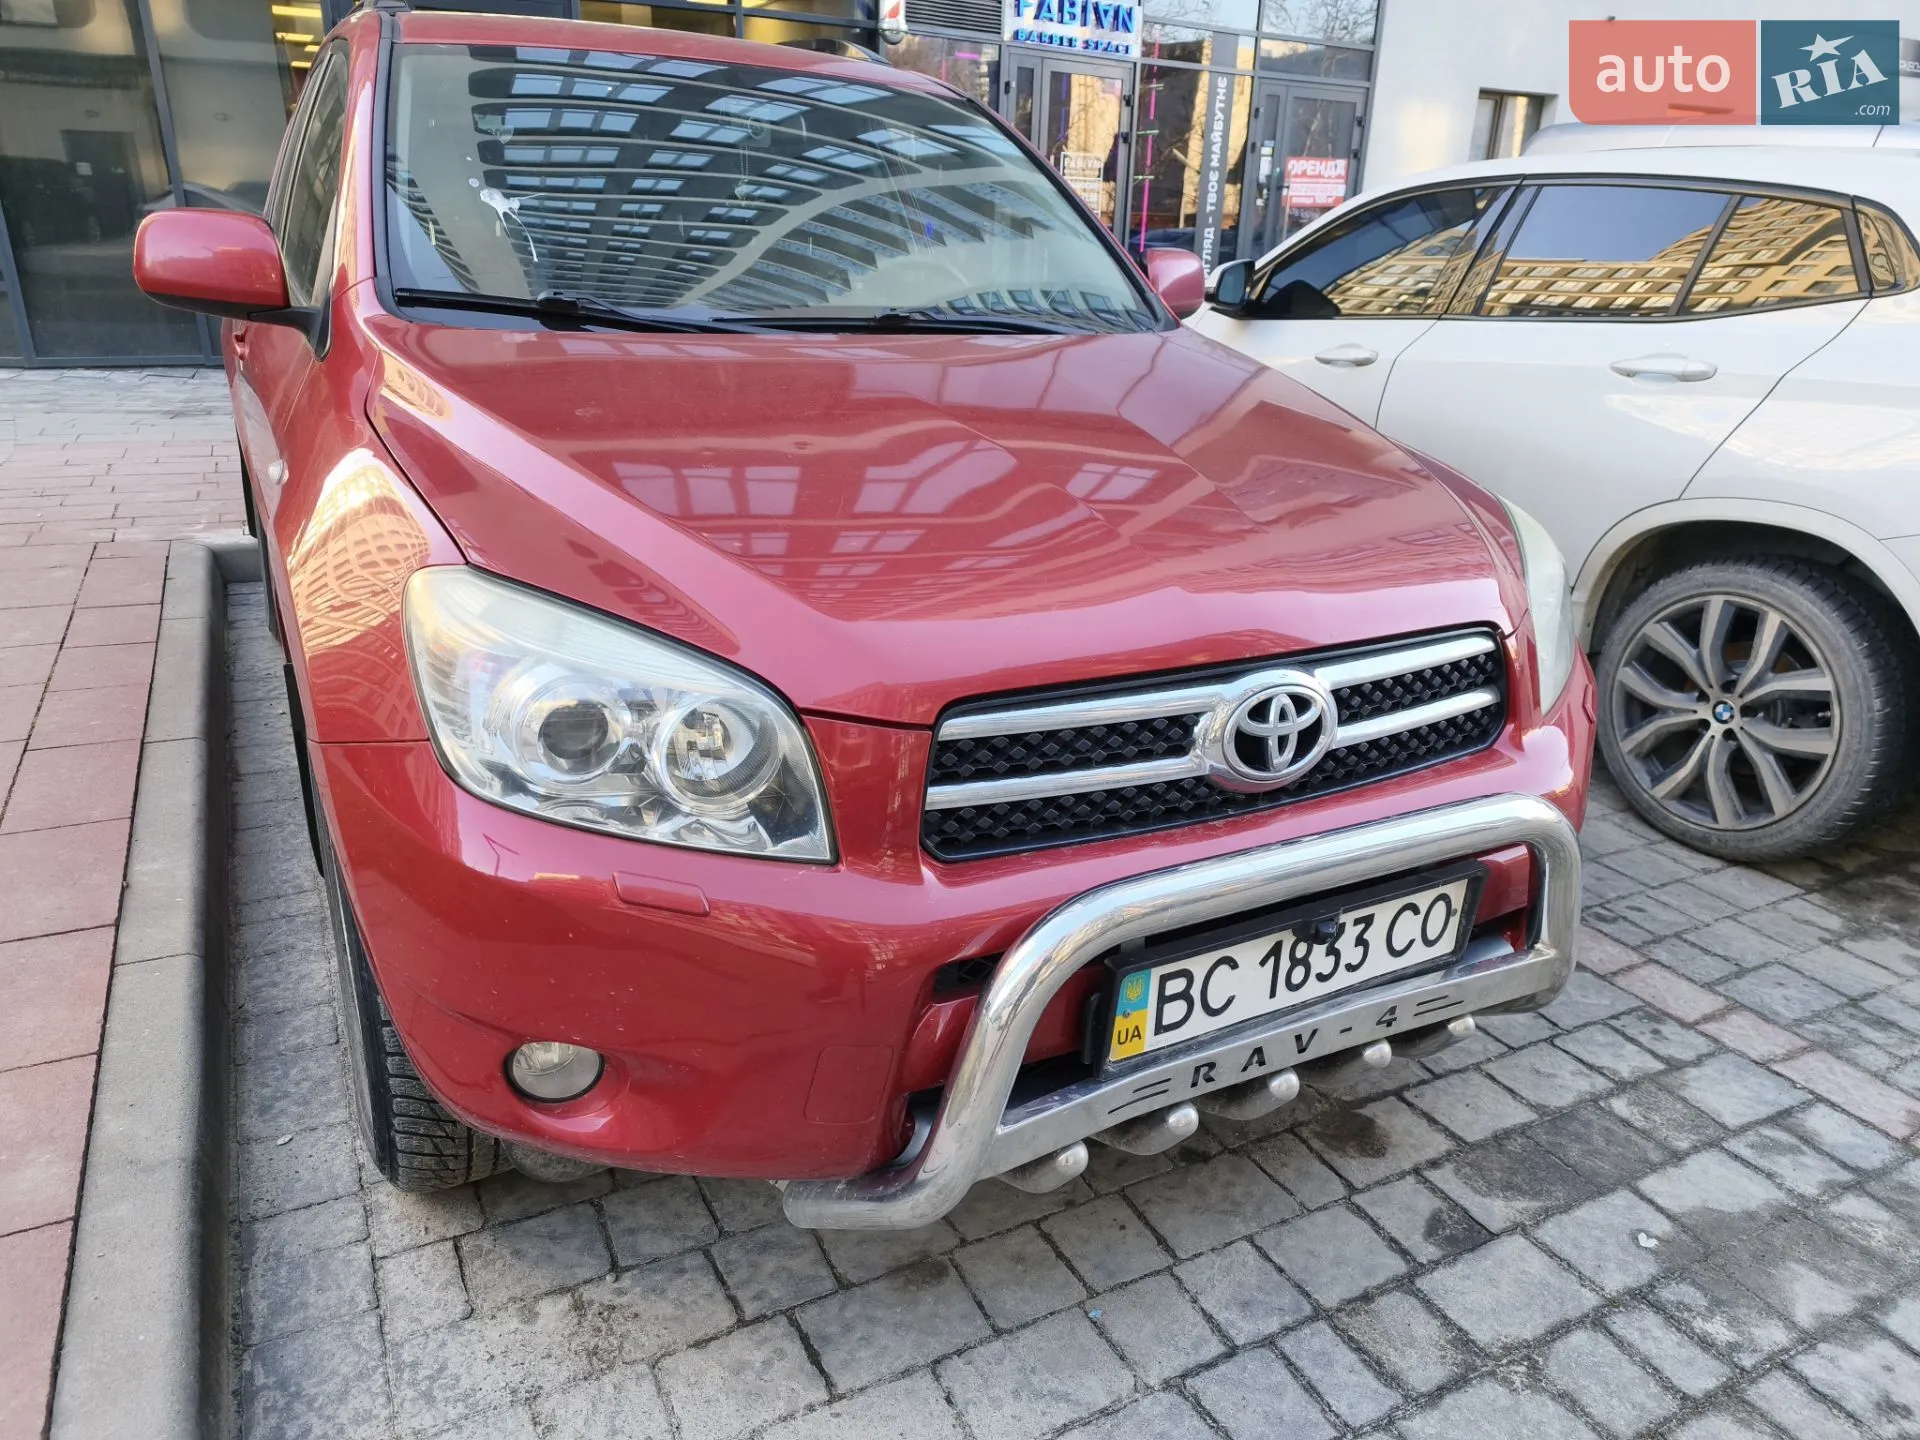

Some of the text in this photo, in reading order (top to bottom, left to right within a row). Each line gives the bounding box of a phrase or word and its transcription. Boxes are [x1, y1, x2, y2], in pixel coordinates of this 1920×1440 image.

[1013, 28, 1132, 55] BARBER SPACE
[1287, 159, 1345, 178] ОРЕНДА
[1154, 892, 1453, 1037] BC 1833 CO
[1117, 1023, 1143, 1046] UA
